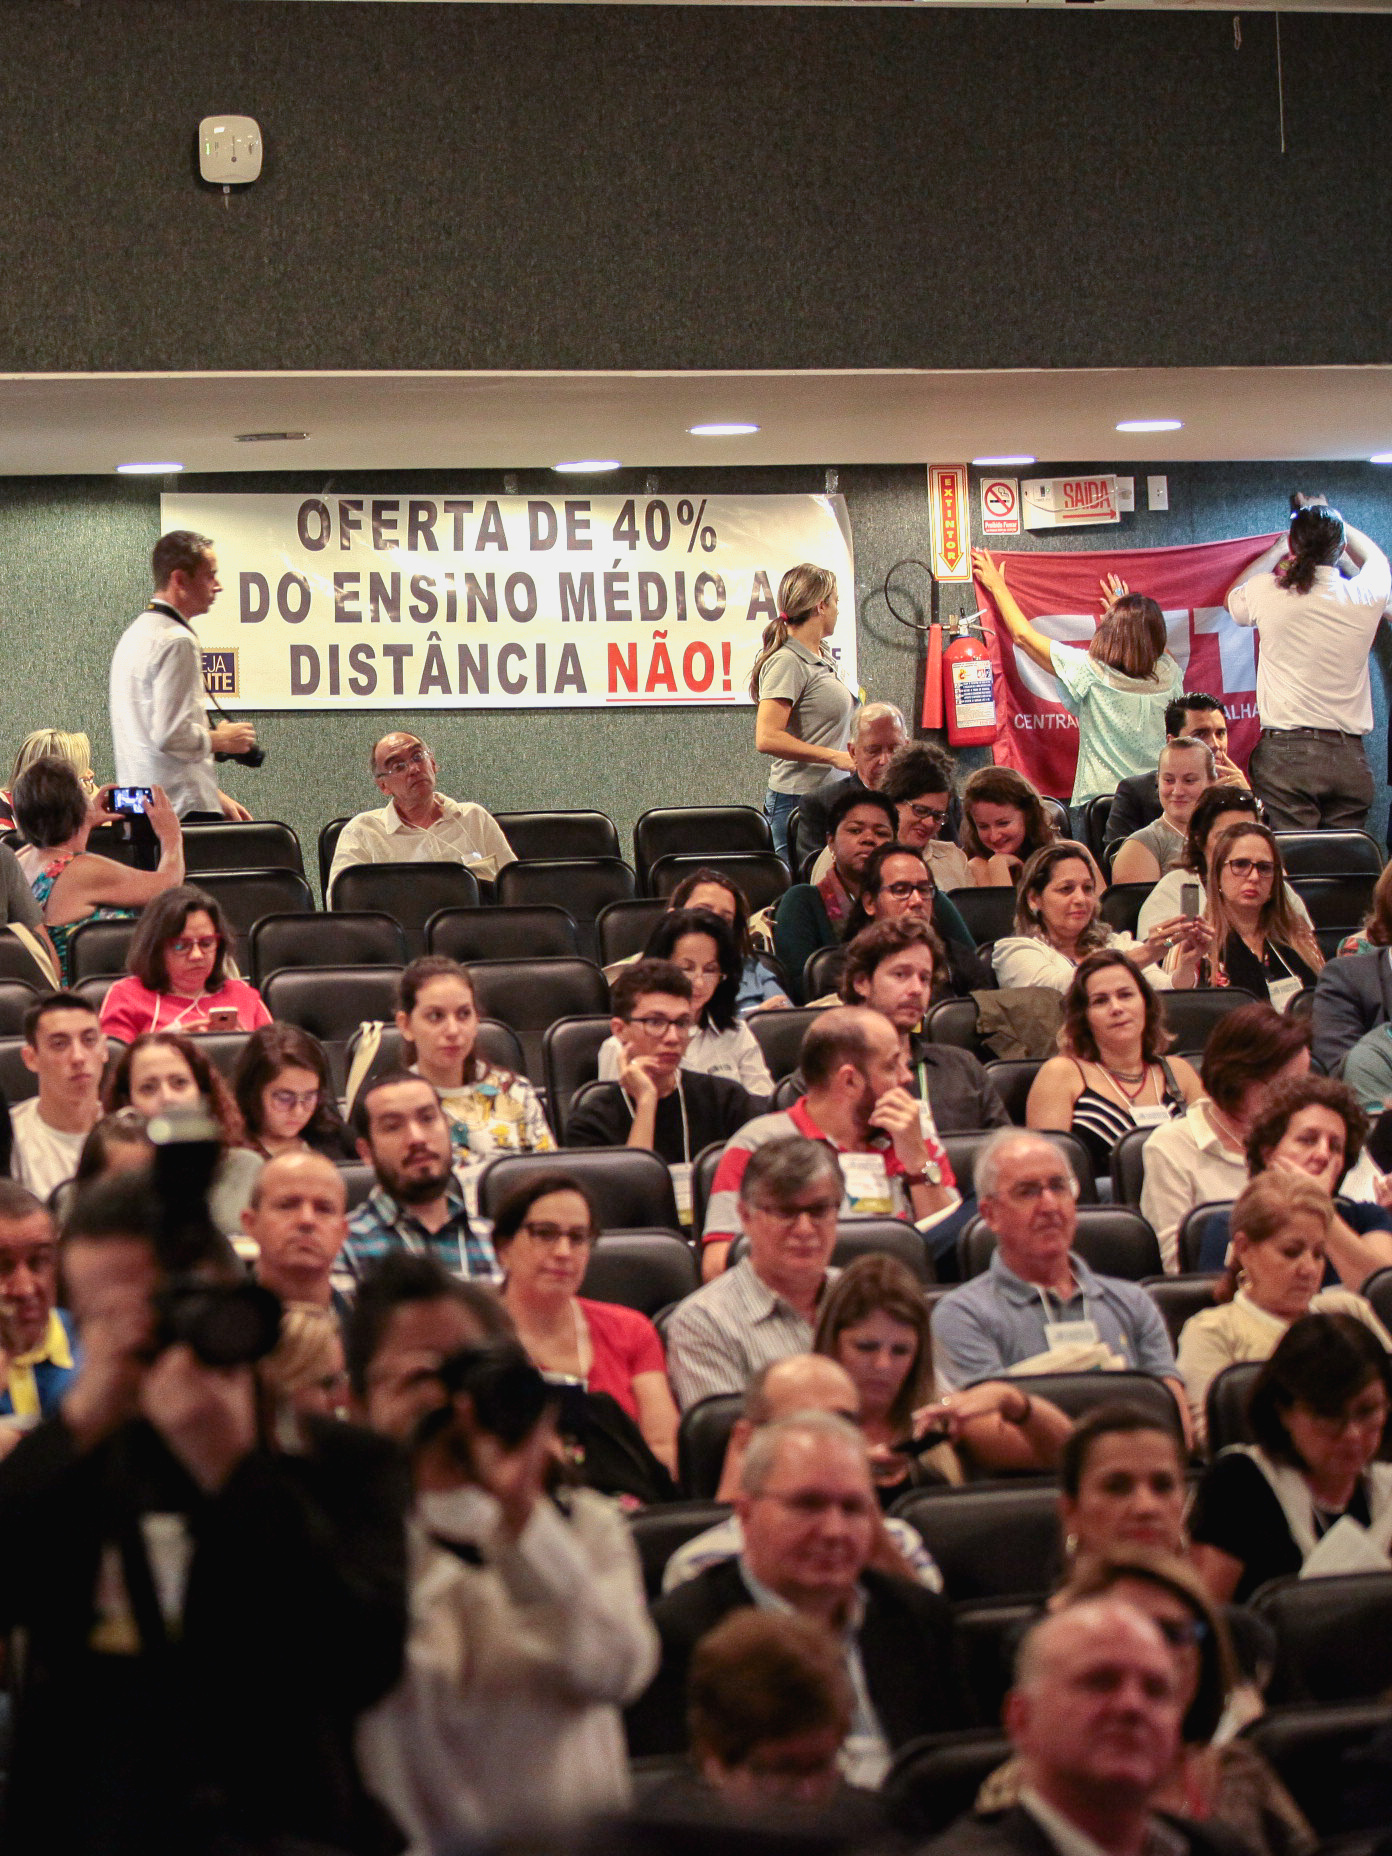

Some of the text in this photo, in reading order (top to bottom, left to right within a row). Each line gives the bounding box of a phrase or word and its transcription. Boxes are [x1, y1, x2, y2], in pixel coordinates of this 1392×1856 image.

[297, 499, 718, 553] OFERTA DE 40%
[943, 479, 957, 559] EXTINTOR
[239, 558, 779, 624] DO ENSINO MÉDIO A
[200, 655, 227, 673] EJA
[290, 630, 732, 697] DISTÂNCIA NÃO!
